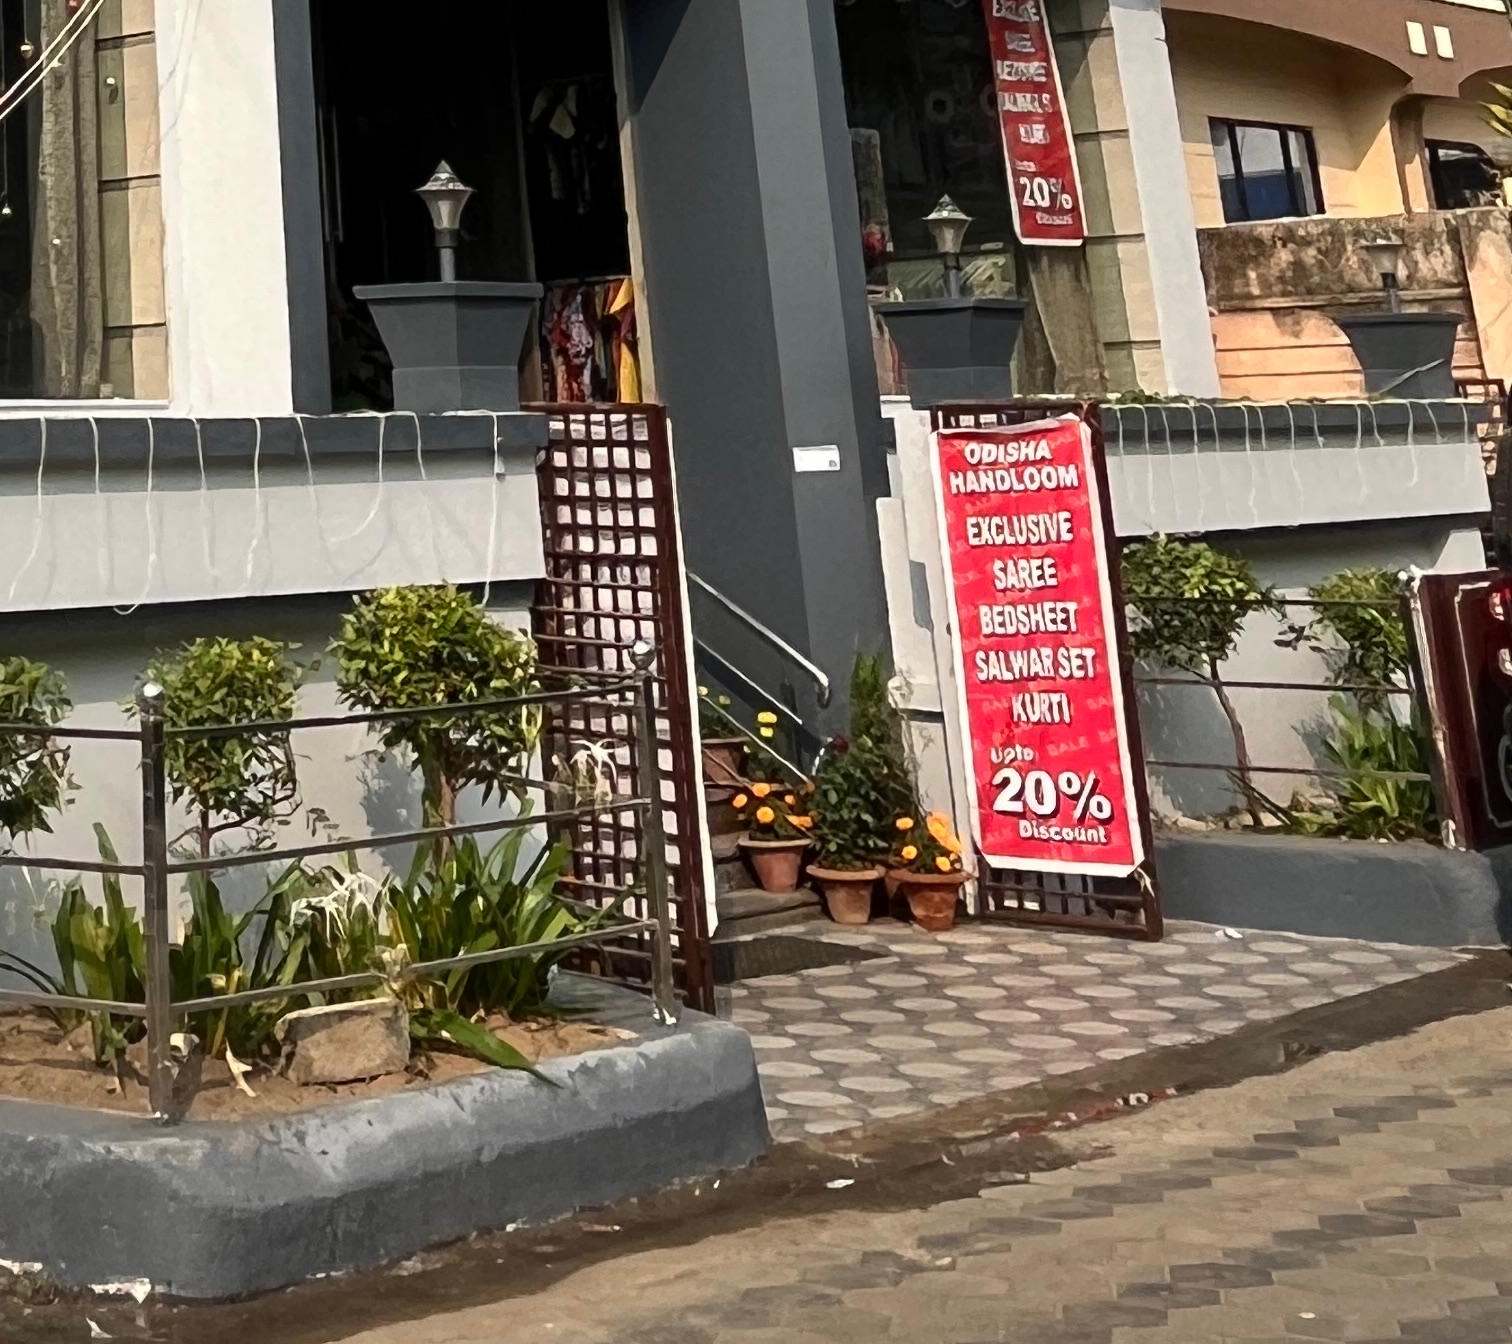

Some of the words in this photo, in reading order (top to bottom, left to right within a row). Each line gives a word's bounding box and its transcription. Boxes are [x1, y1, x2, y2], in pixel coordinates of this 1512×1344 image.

[1019, 176, 1073, 211] 20%
[964, 439, 1053, 465] ODISHA
[949, 464, 1079, 494] HANDLOOM
[966, 511, 1073, 546] EXCLUSIVE
[993, 557, 1058, 591] SAREE
[978, 601, 1078, 635] BEDSHEET
[975, 647, 1055, 681] SALWAR
[1057, 647, 1097, 679] SET
[1011, 692, 1071, 724] KURTI
[991, 767, 1113, 823] 20%
[1019, 819, 1108, 843] Discount
